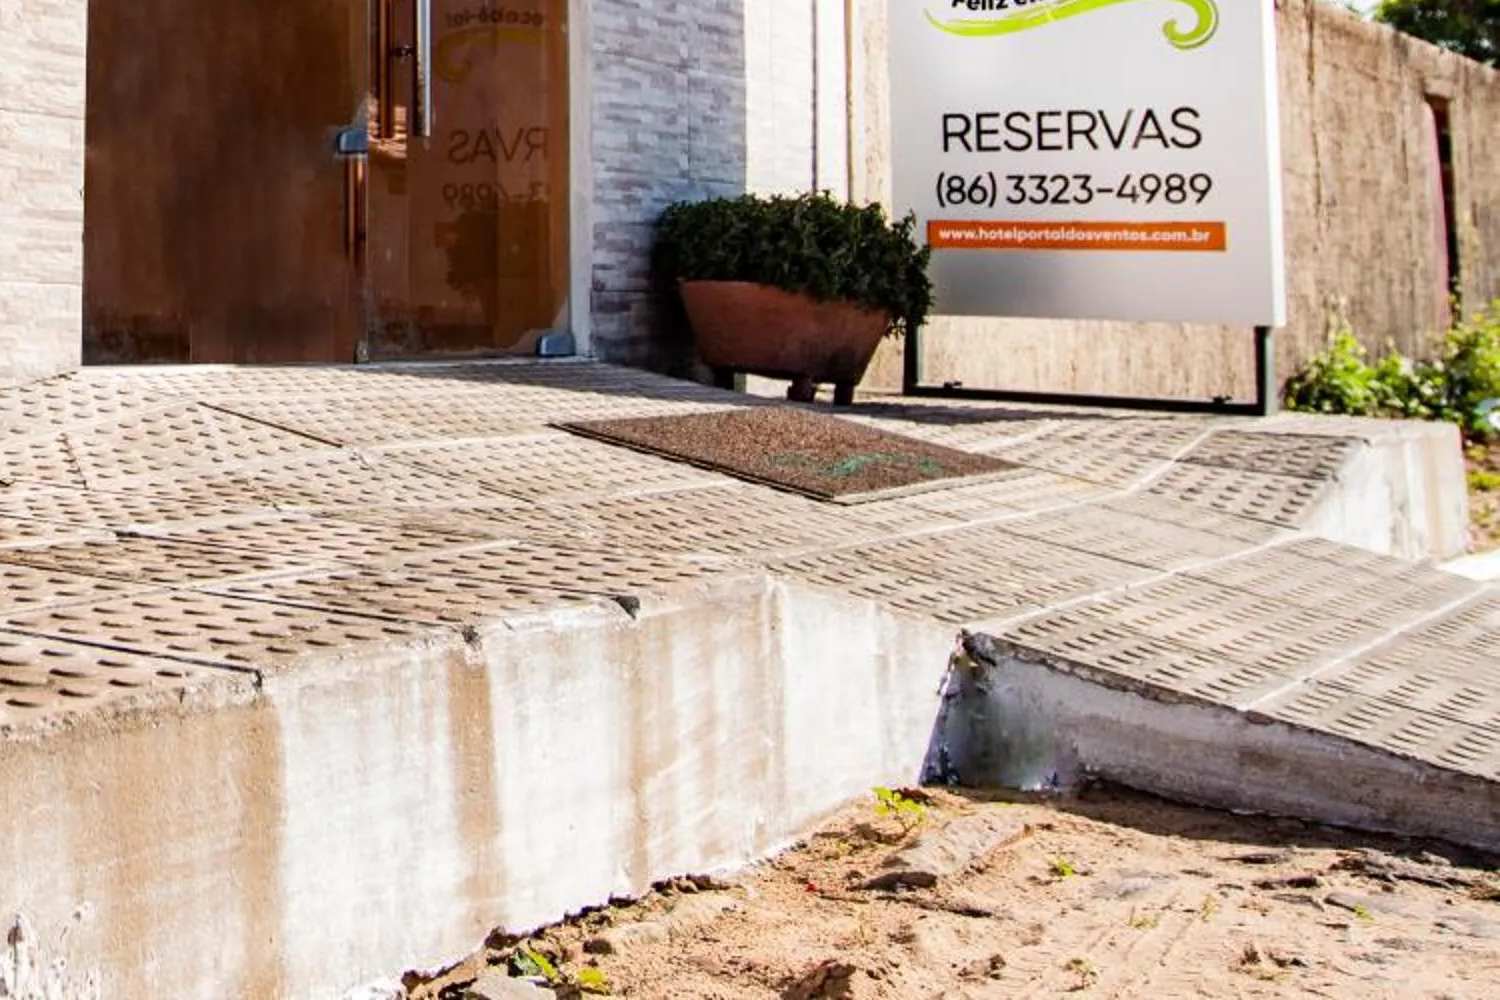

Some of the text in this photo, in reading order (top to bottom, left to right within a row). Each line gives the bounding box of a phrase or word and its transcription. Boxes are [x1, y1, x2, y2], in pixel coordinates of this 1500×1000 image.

[942, 107, 1203, 152] RESERVAS
[936, 171, 1213, 209] (86) 3323-4989
[938, 225, 1212, 244] www.hotelportaldosventos.com.br
